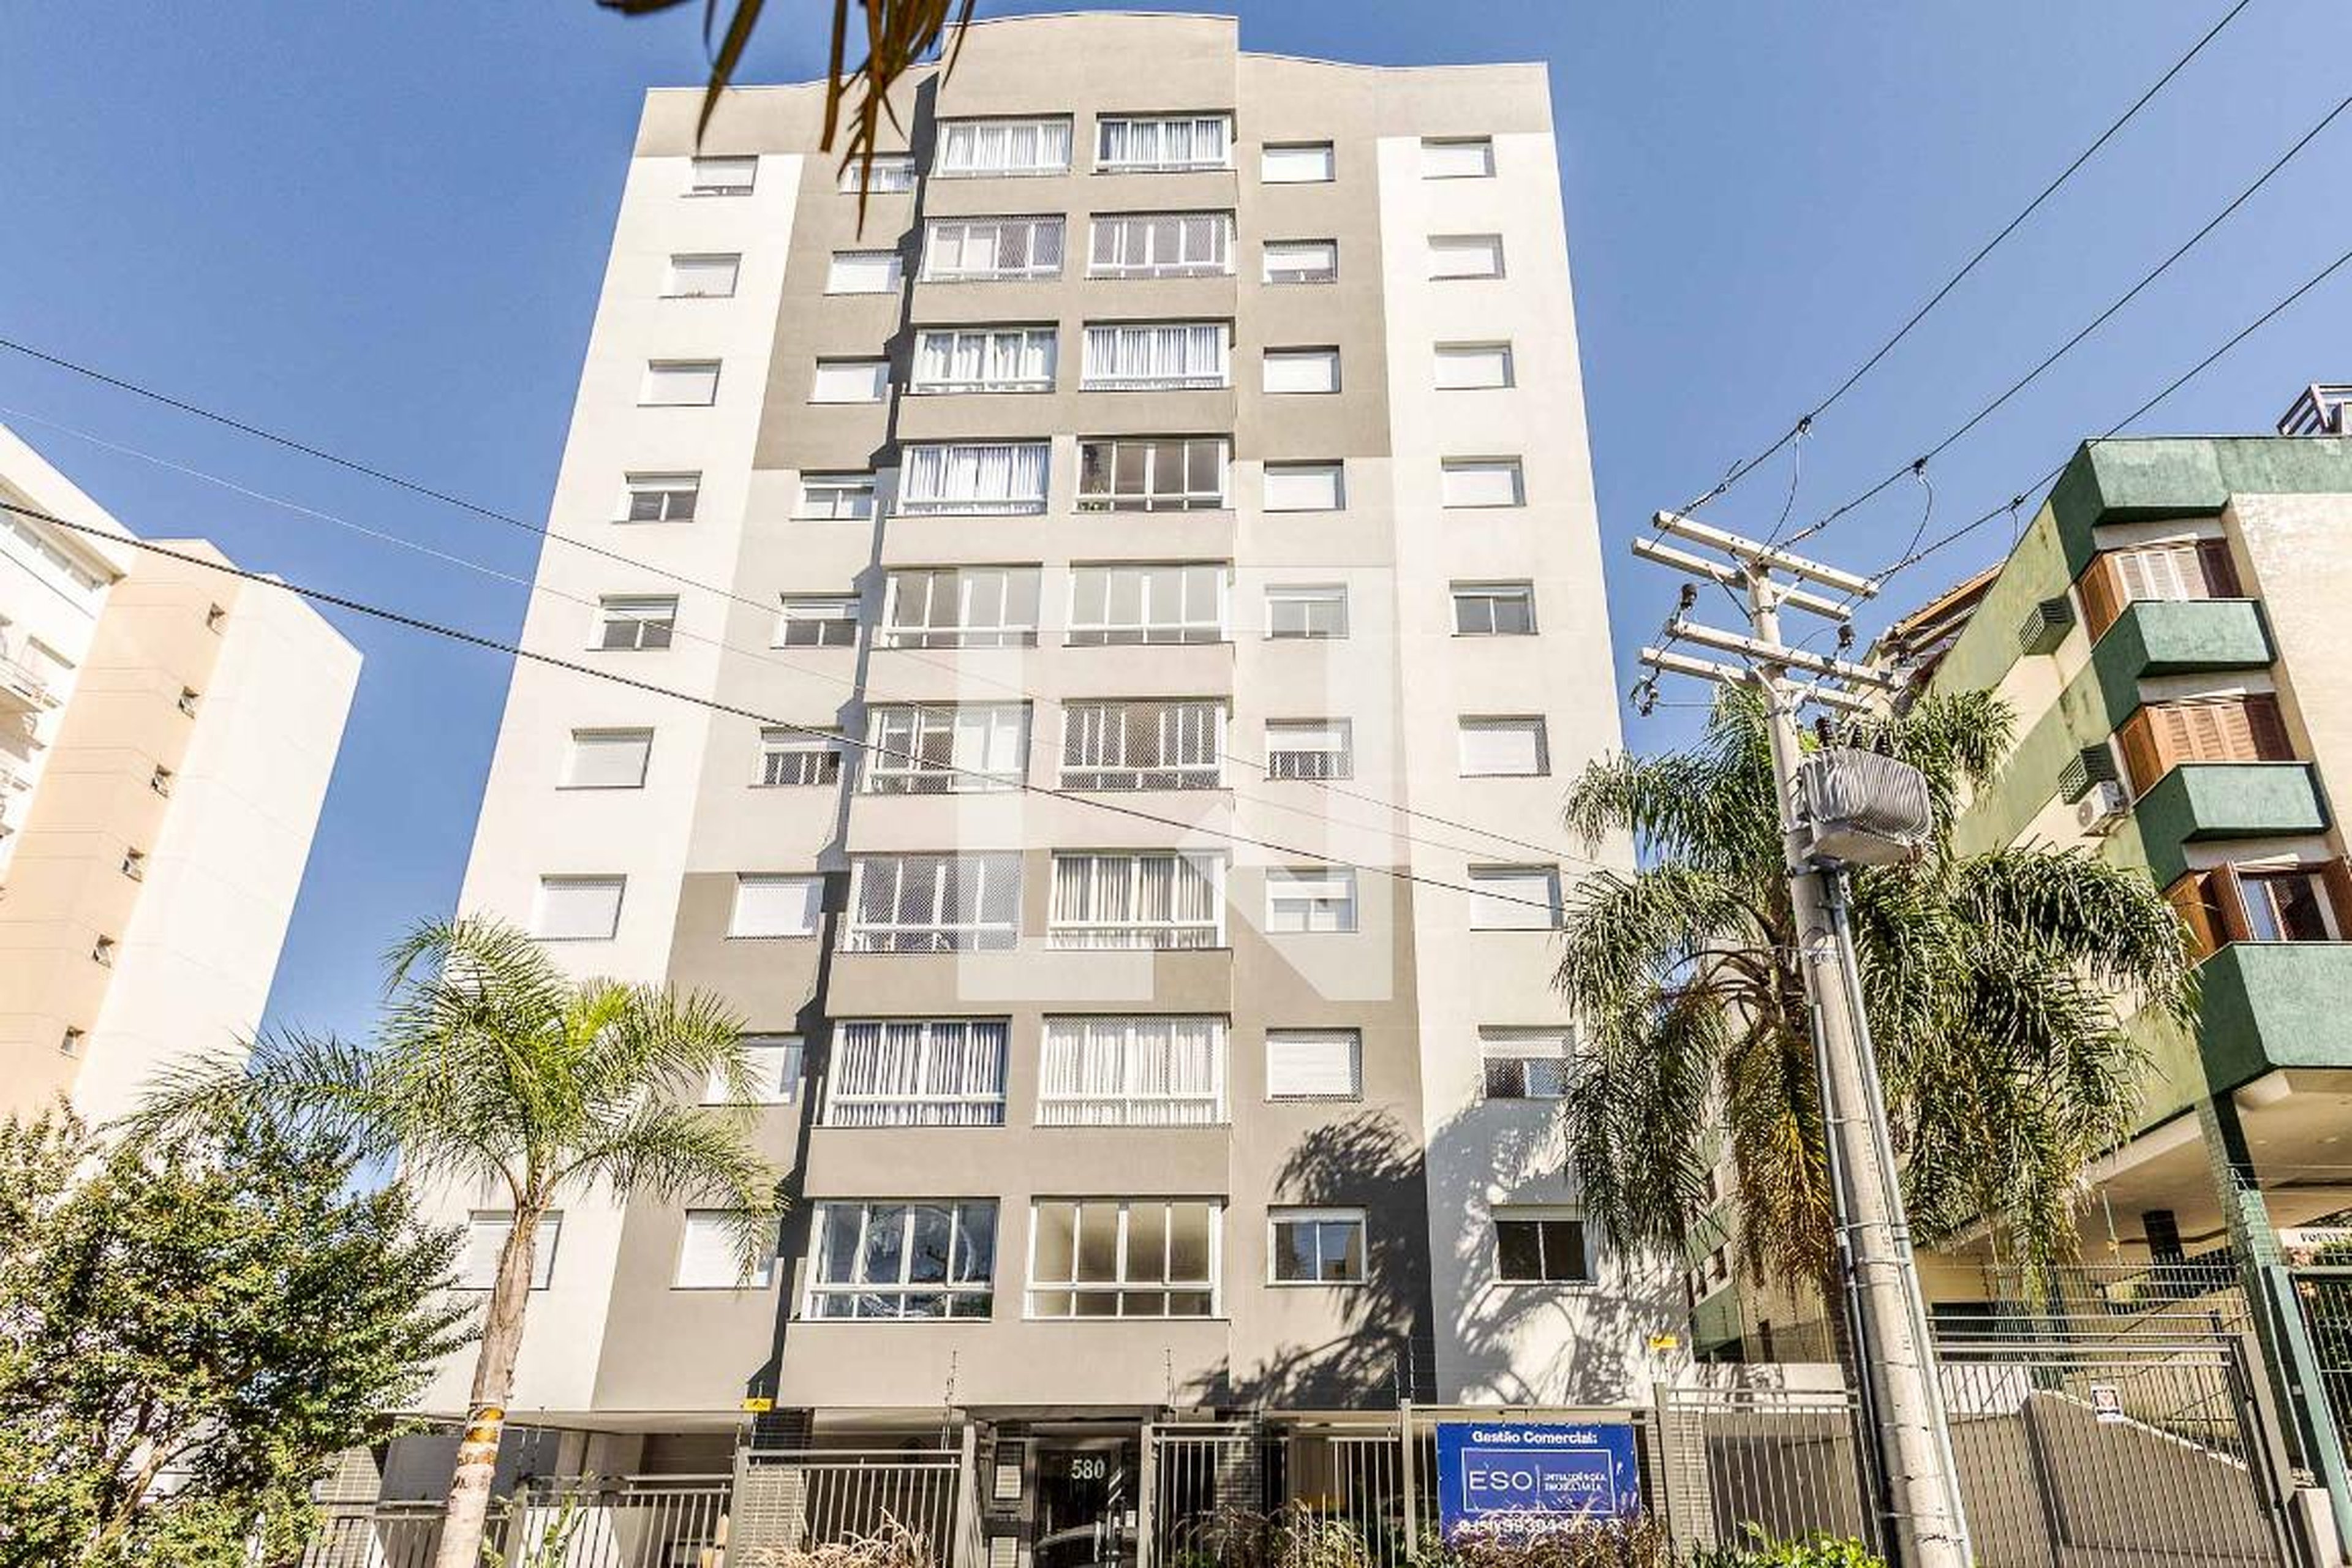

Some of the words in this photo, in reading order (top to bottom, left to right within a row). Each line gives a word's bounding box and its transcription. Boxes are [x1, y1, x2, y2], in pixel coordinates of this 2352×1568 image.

[1472, 1430, 1520, 1443] Gestão
[1071, 1459, 1105, 1479] 580
[1470, 1471, 1532, 1491] ESO
